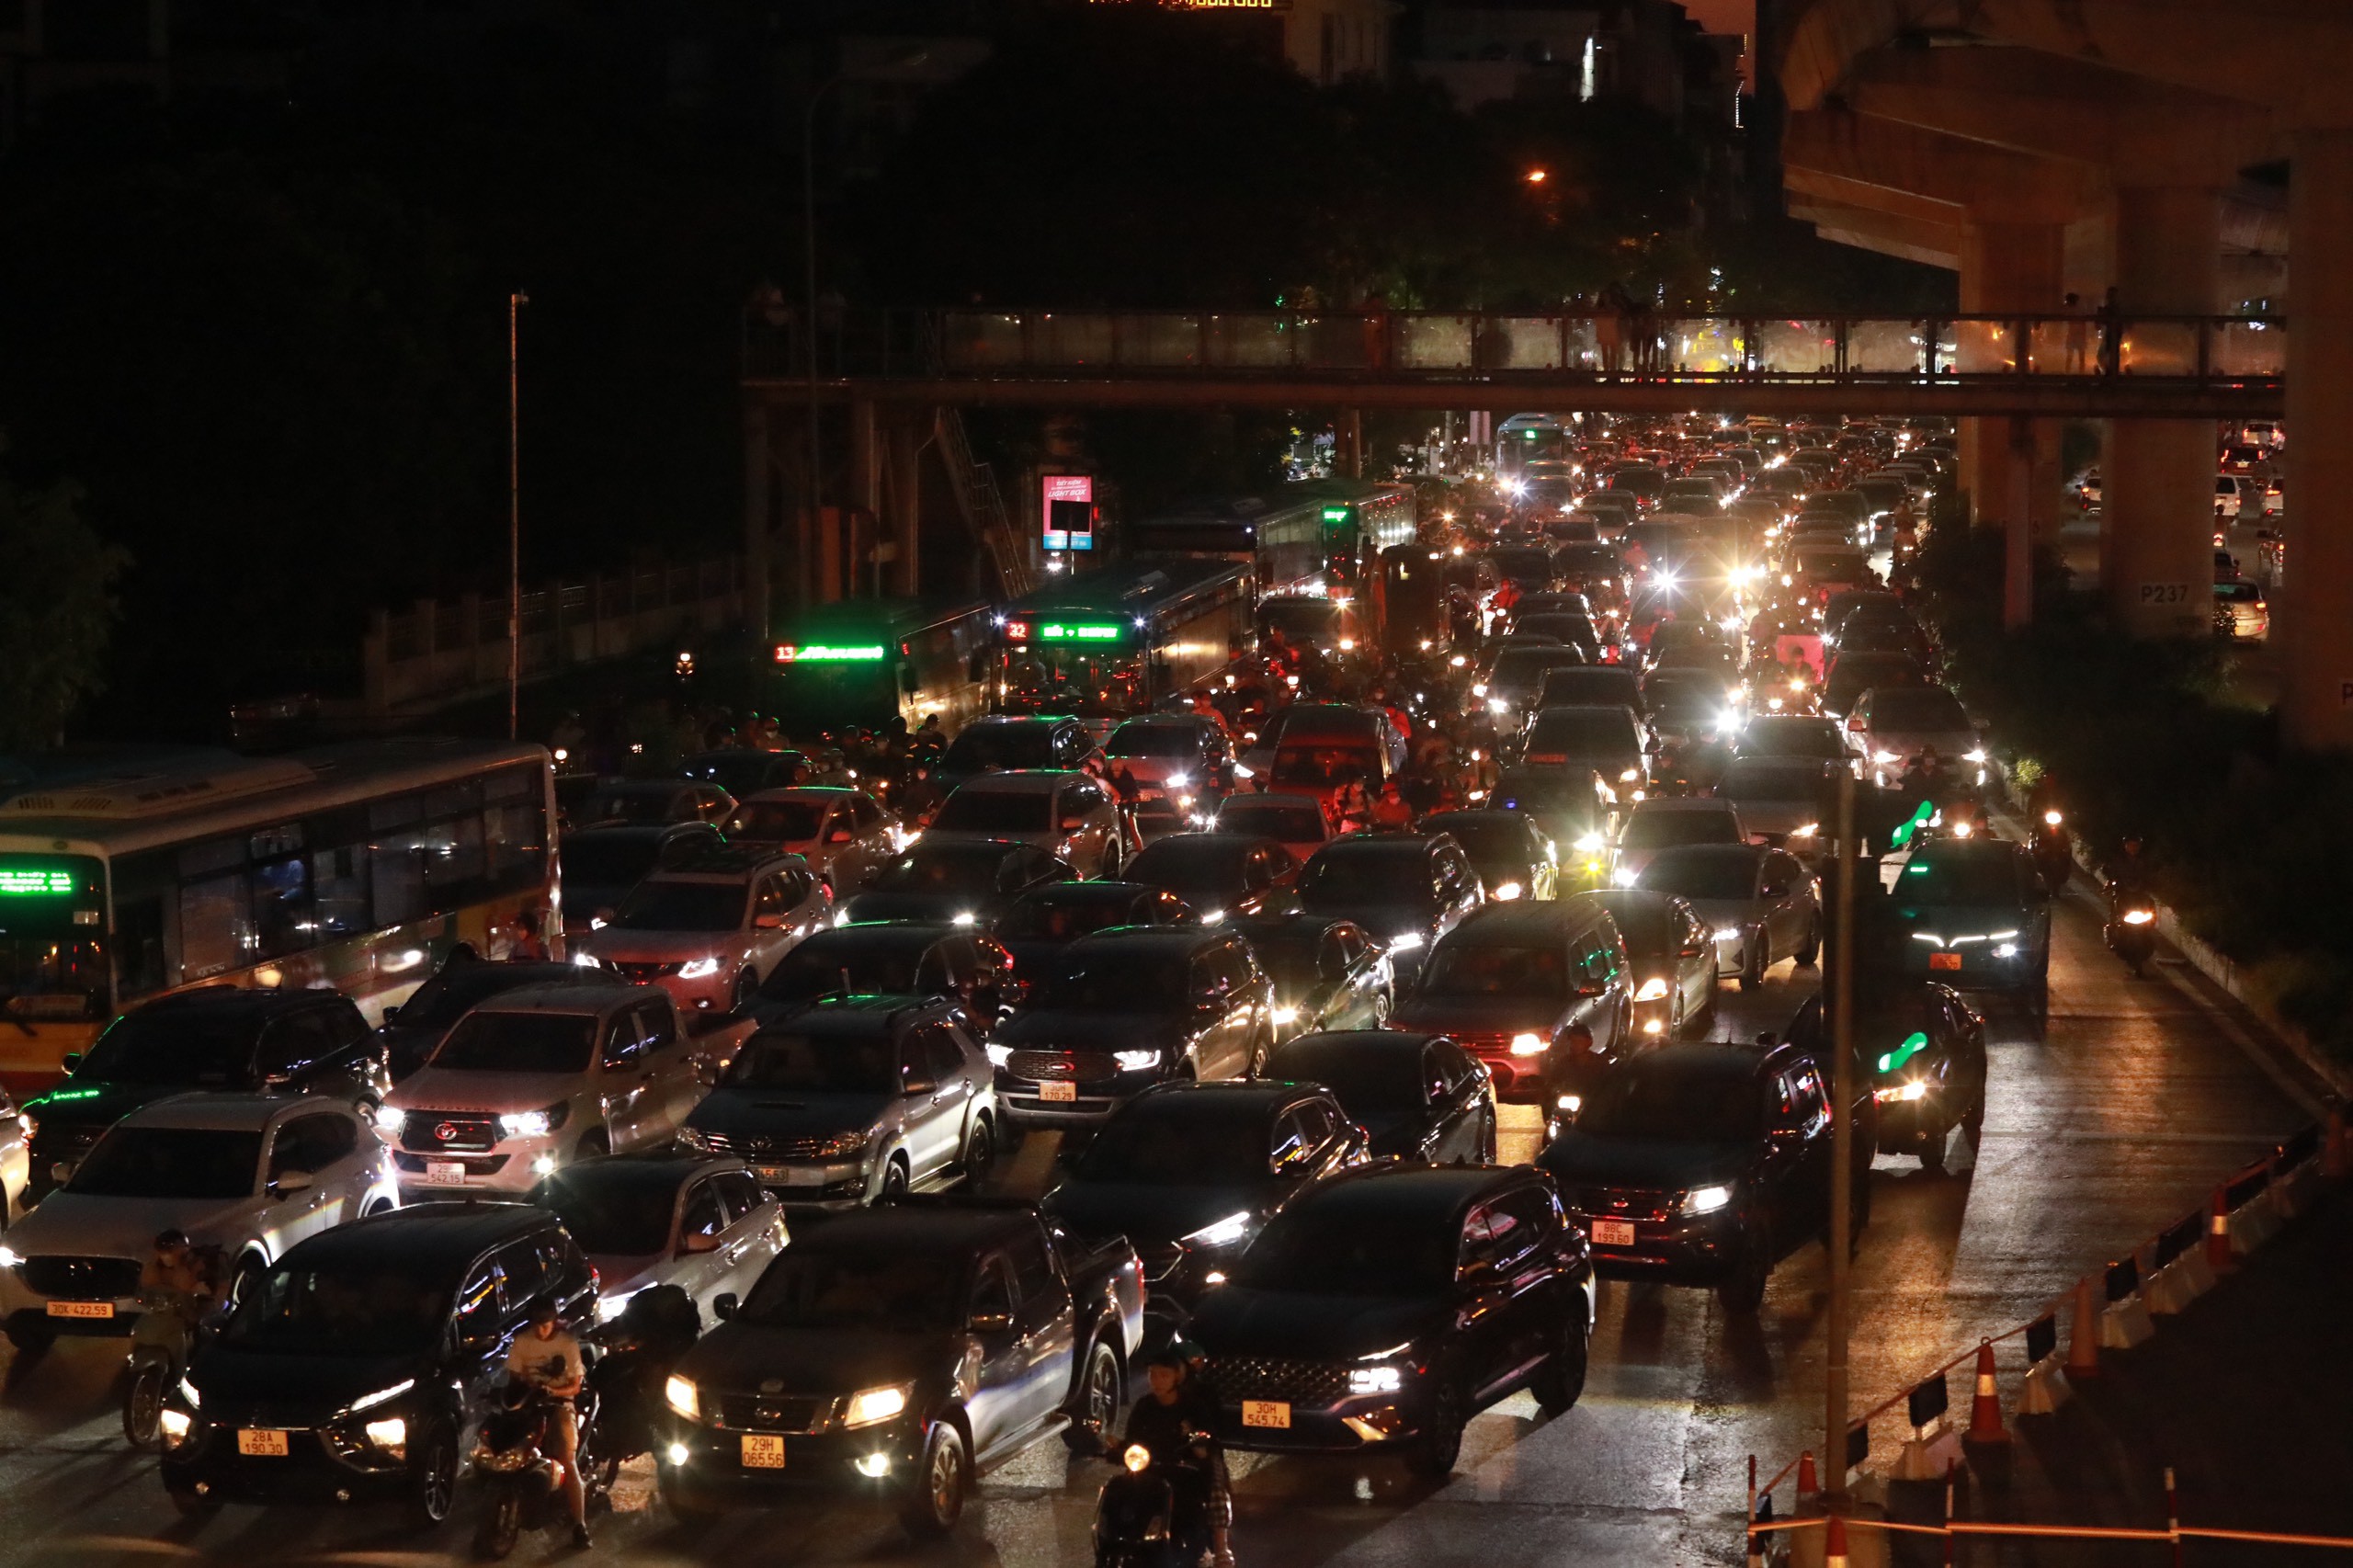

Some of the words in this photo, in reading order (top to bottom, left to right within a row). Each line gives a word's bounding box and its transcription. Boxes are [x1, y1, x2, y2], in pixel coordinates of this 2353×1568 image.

[2142, 585, 2188, 603] P237
[1247, 1414, 1284, 1426] 545.74
[251, 1431, 273, 1442] 28A
[244, 1443, 283, 1454] 190.30
[751, 1437, 774, 1451] 29H
[743, 1452, 783, 1467] 065.56
